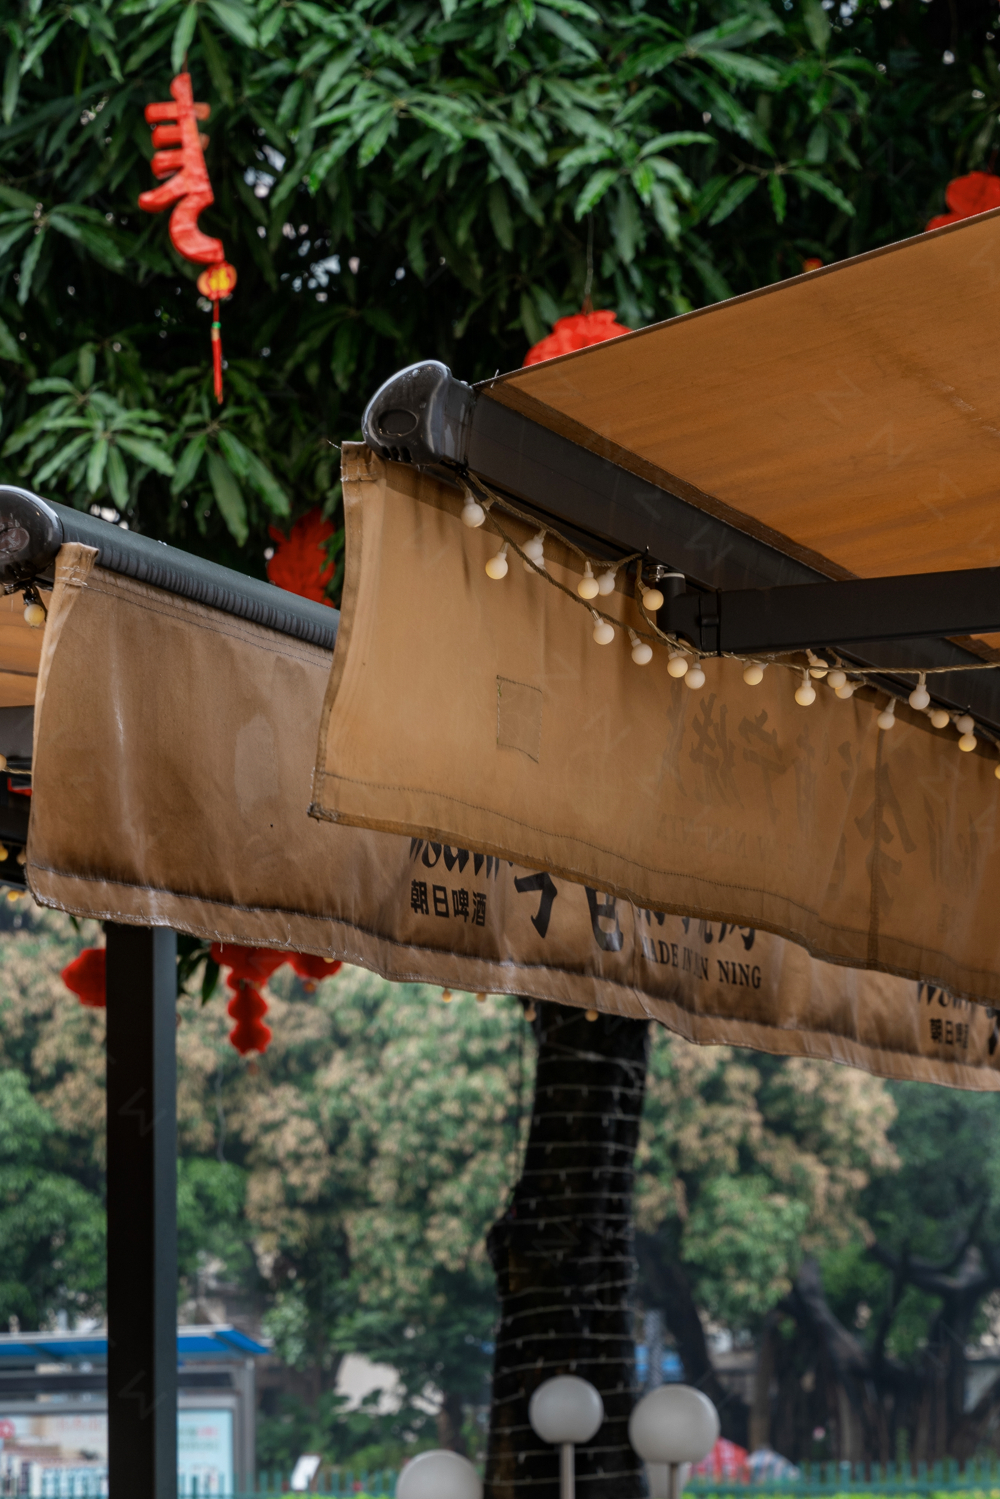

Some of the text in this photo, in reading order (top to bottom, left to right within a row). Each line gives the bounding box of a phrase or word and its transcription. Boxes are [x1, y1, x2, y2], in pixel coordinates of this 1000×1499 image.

[409, 878, 488, 928] 朝日啤酒
[717, 959, 761, 989] NING
